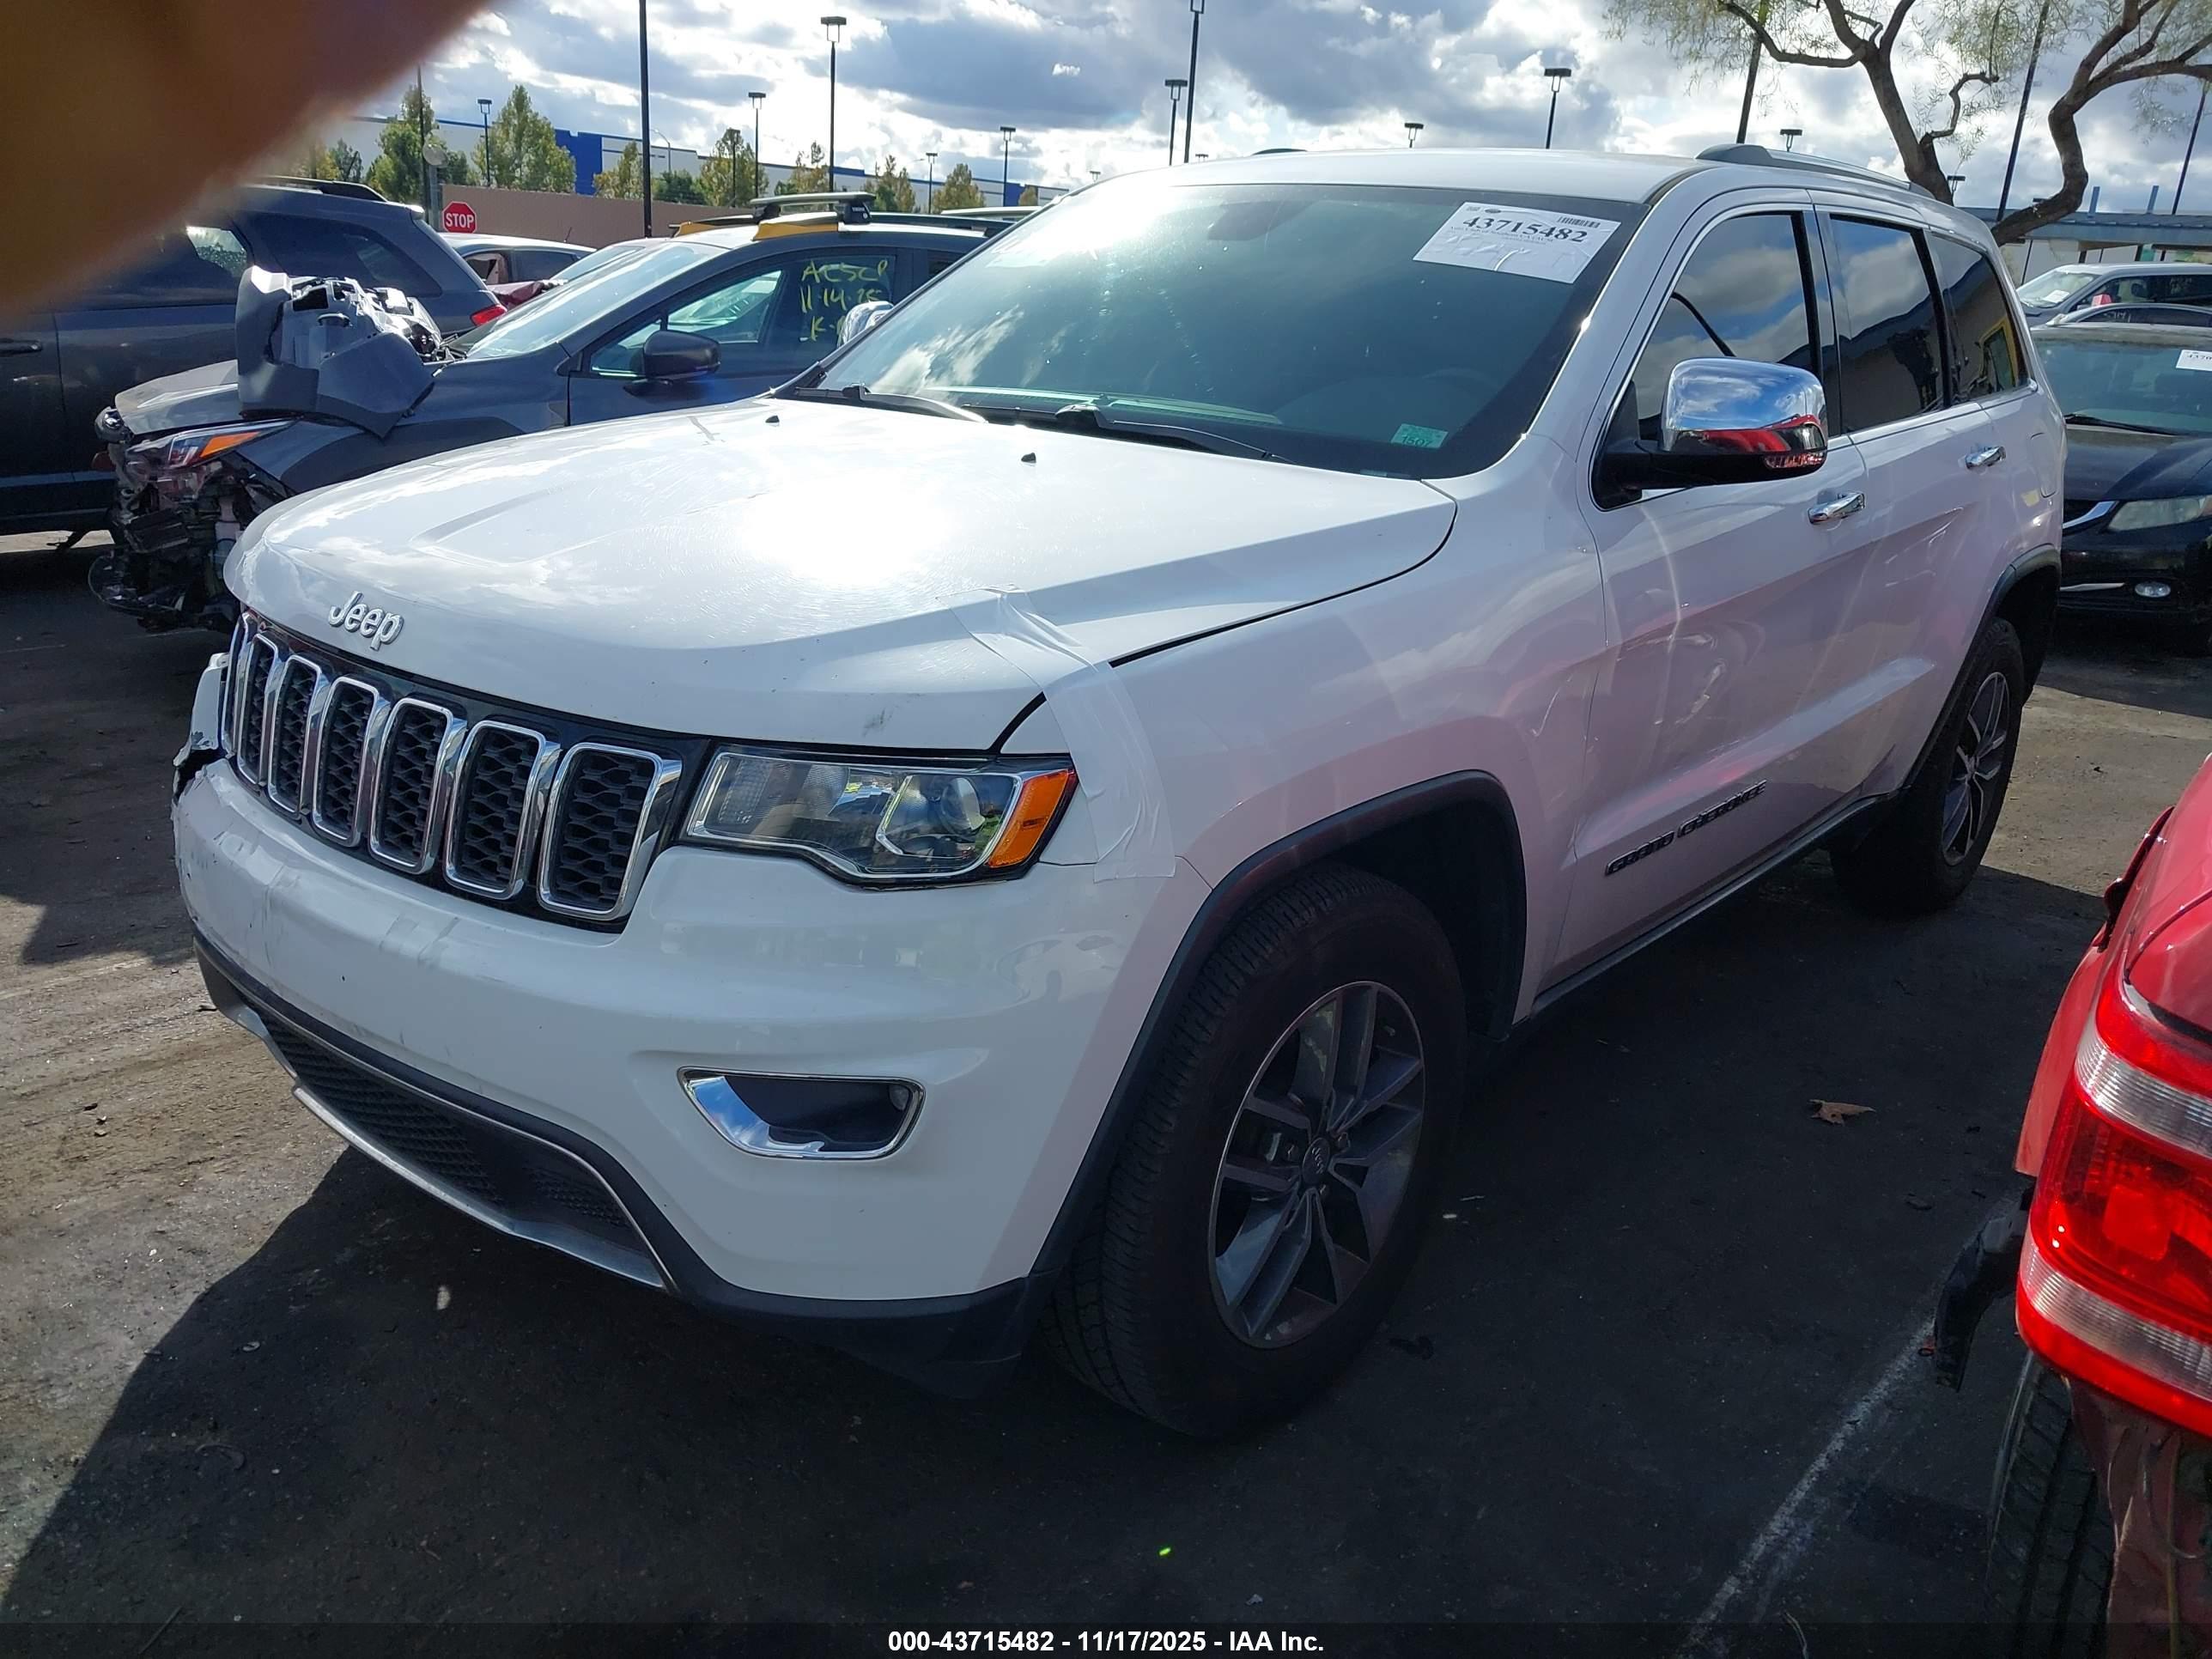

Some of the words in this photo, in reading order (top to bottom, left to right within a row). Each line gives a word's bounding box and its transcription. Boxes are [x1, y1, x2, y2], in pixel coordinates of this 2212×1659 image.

[446, 212, 474, 228] STOP
[1462, 216, 1588, 243] 43715482
[1401, 434, 1433, 447] 1507
[328, 591, 404, 651] Jeep
